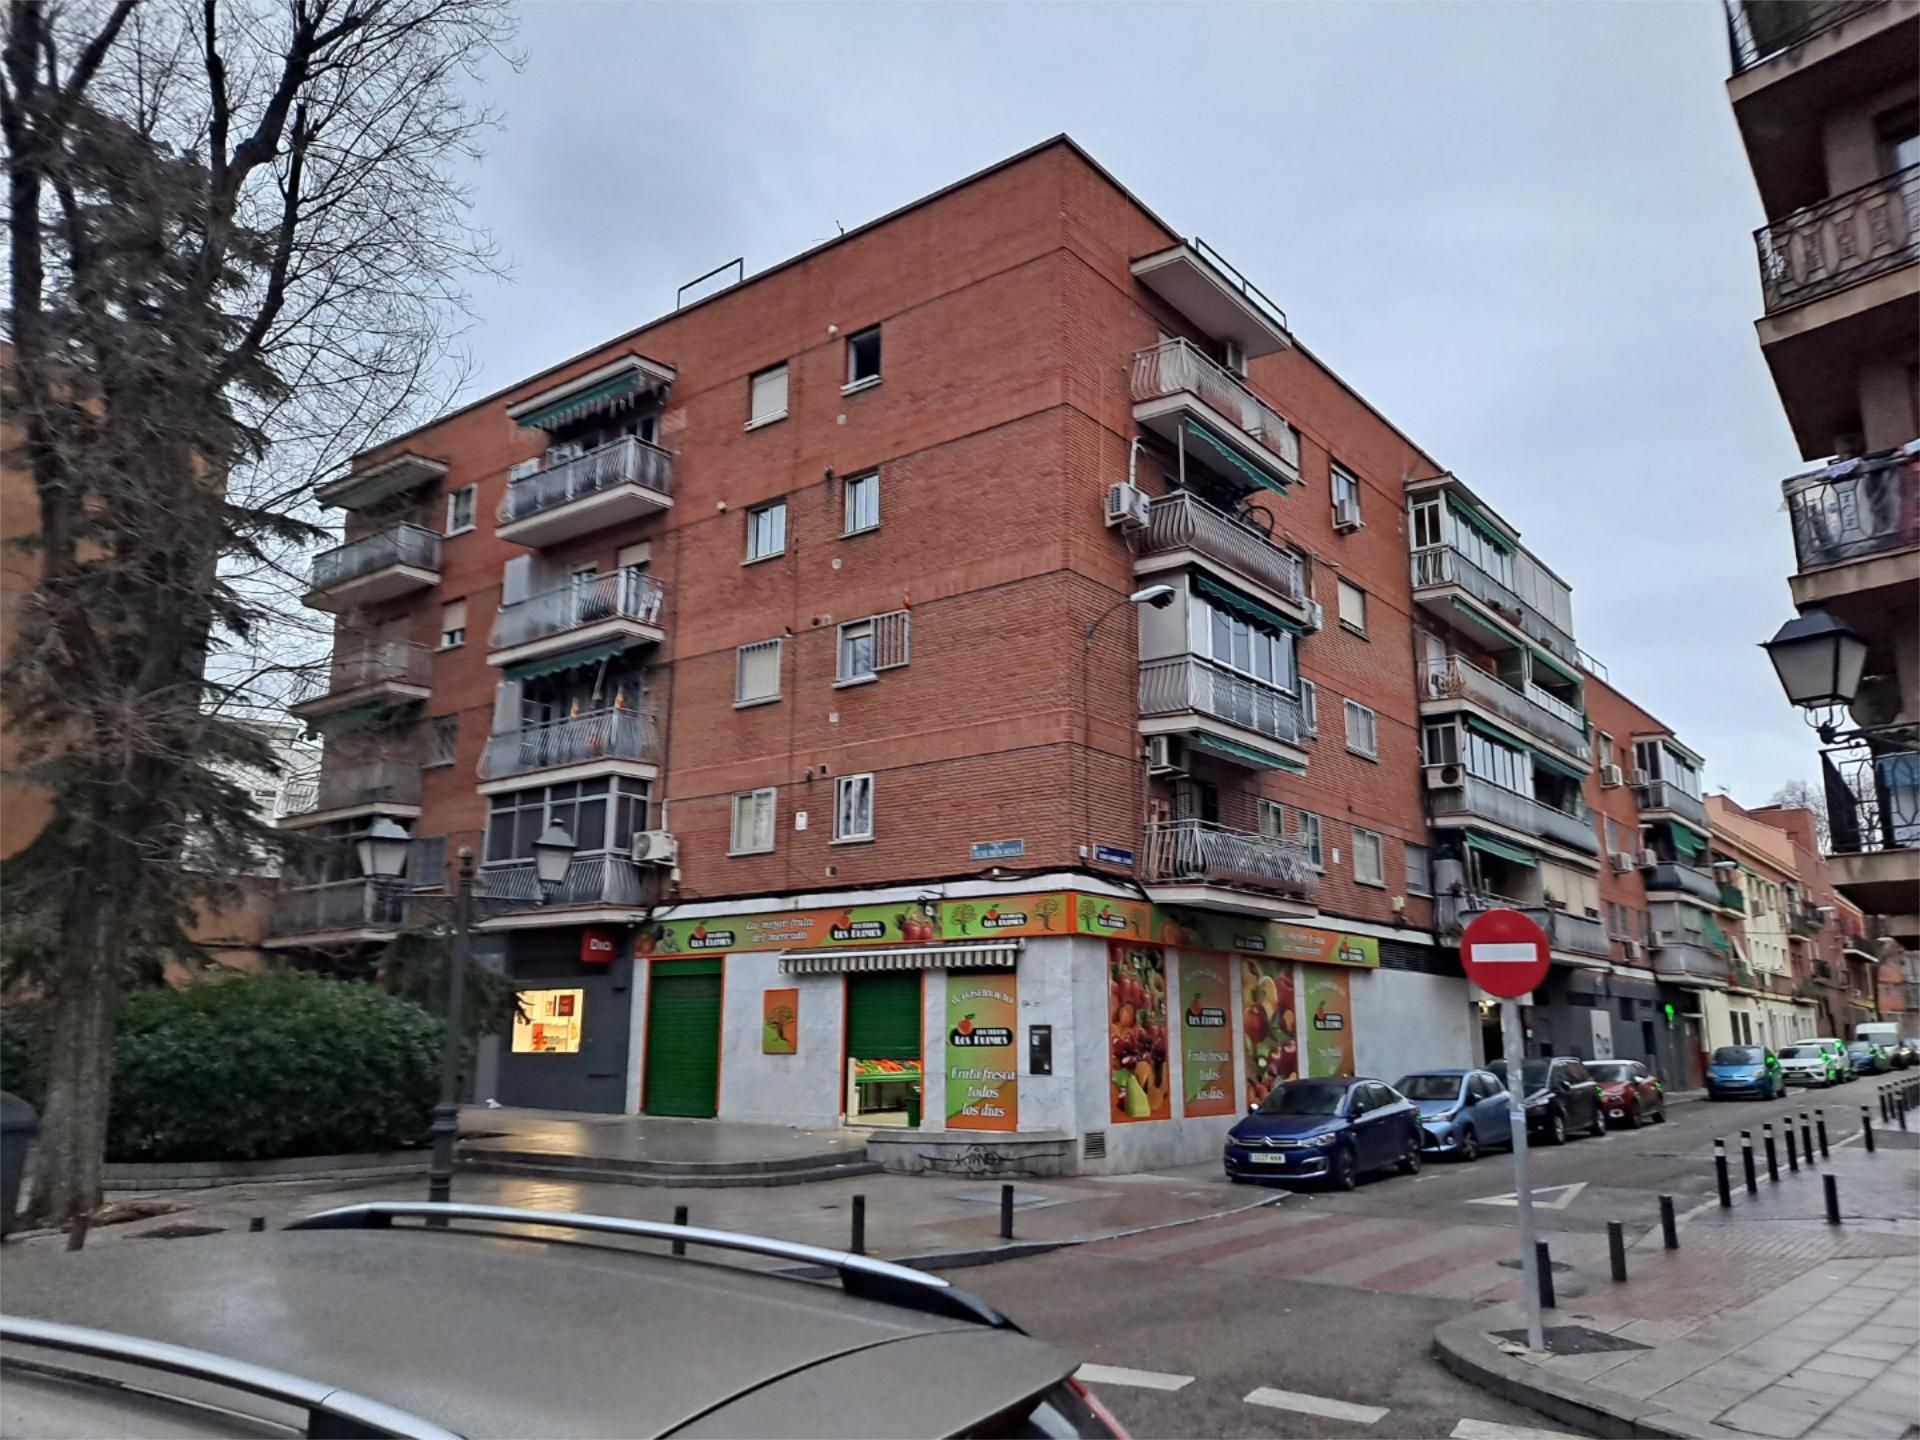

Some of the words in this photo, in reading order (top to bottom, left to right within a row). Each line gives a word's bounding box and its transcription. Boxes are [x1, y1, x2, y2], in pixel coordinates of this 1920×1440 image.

[951, 1066, 983, 1080] Fruta
[982, 1068, 1016, 1083] fresca
[968, 1084, 999, 1098] todos
[961, 1102, 979, 1116] los
